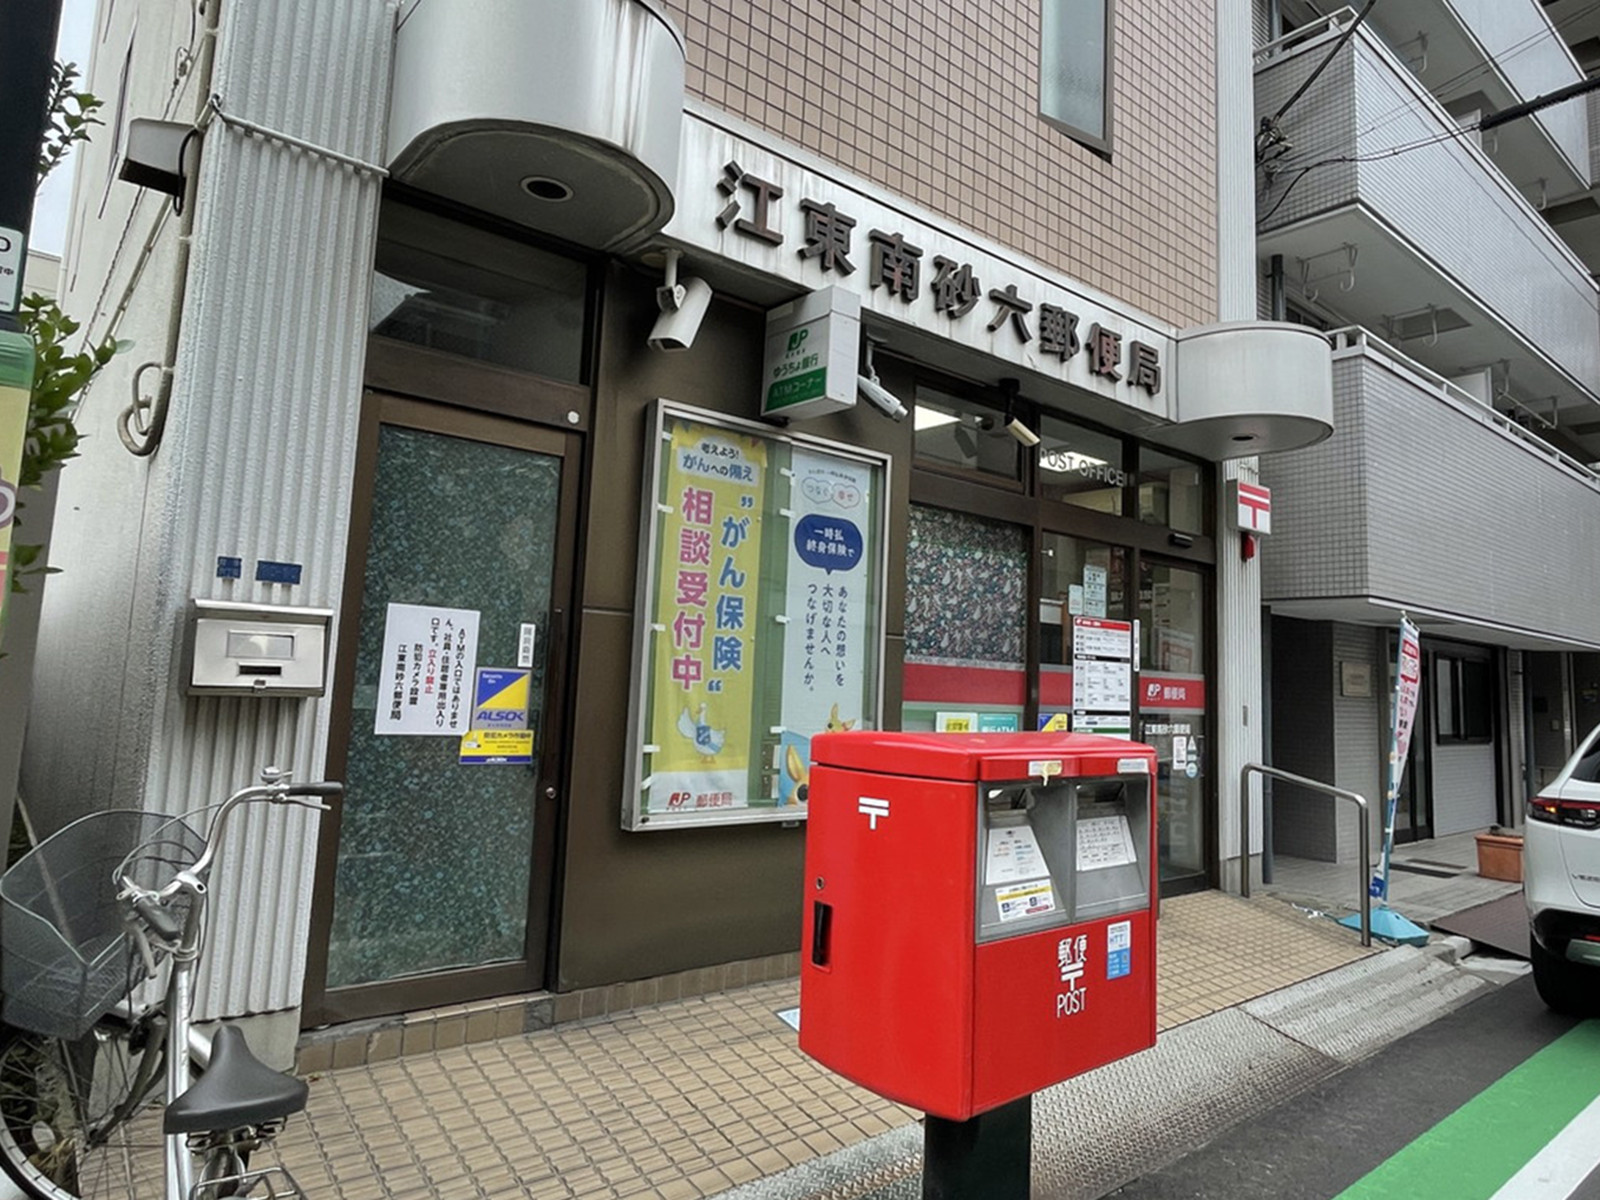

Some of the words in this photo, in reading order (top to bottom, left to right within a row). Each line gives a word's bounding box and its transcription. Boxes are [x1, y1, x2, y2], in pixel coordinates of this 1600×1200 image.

[715, 160, 1162, 396] 江東南砂六郵便局
[773, 353, 819, 379] ゆうちょ銀行
[772, 377, 823, 398] ATMコーナー
[683, 454, 754, 482] がんへの備え
[1039, 447, 1075, 473] POST
[1079, 459, 1124, 488] OFFICE
[806, 538, 856, 557] 終身保険で
[813, 527, 844, 542] 一時払
[671, 486, 714, 692] 相談受付中
[820, 584, 834, 656] 大切な人へ
[803, 584, 818, 692] つなげませんか。
[835, 586, 848, 687] あなたの想いを
[389, 644, 408, 721] 江東南砂六郵便局
[408, 643, 424, 706] 防犯カメラ設置
[1163, 686, 1187, 701] 郵便局
[476, 710, 526, 722] ALSOK
[696, 791, 733, 808] 郵便局
[1057, 934, 1087, 967] 郵便
[1056, 986, 1088, 1018] POST
